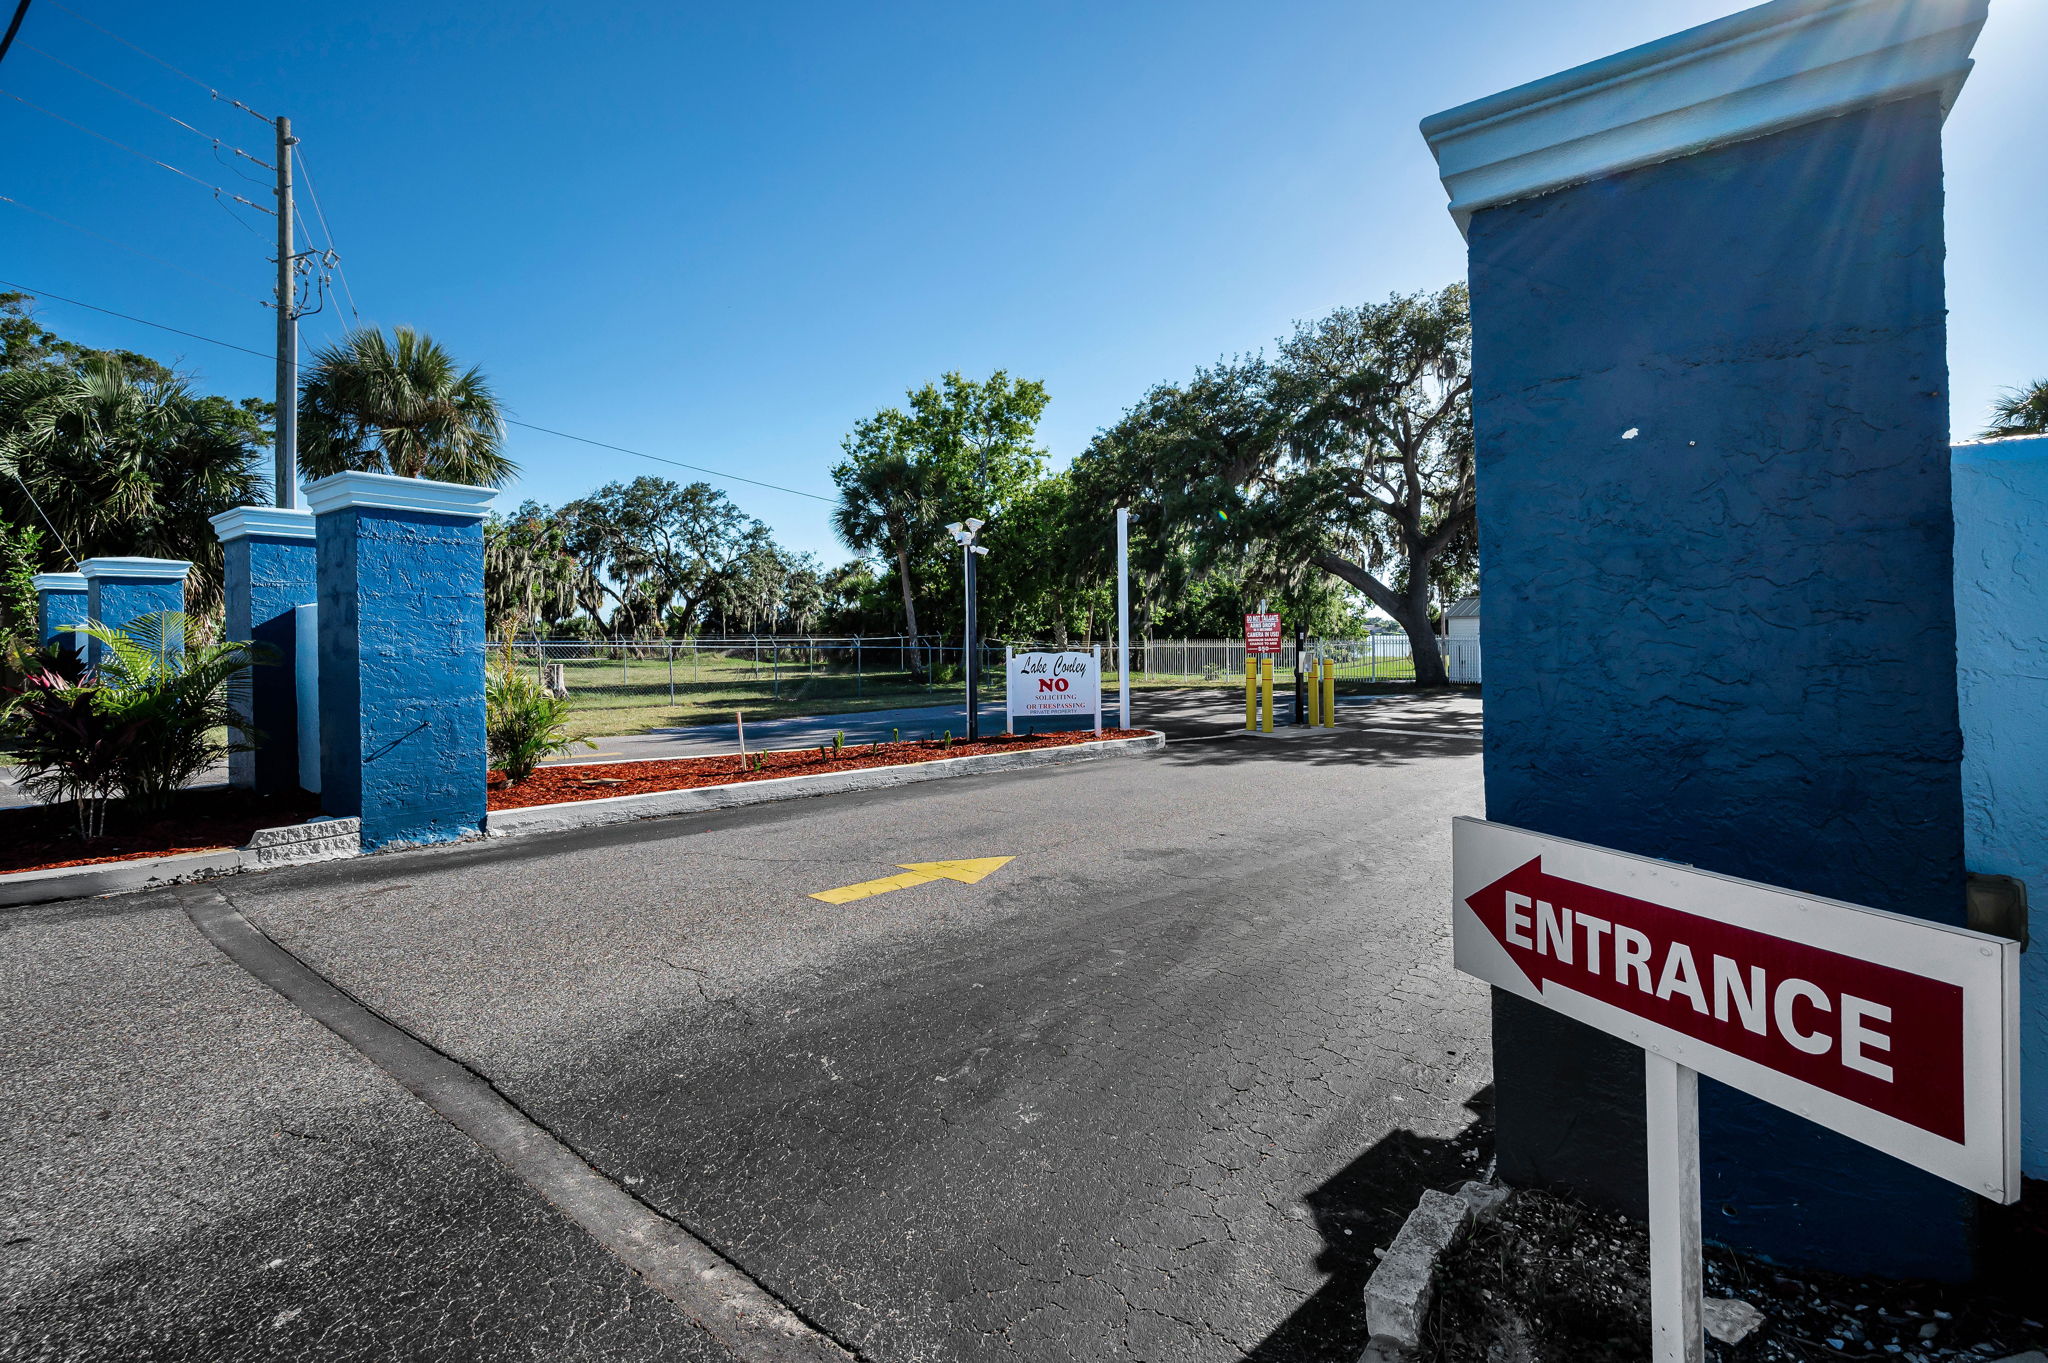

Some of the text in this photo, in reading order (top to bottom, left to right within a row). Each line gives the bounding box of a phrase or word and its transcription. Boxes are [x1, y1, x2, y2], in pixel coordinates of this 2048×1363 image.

[1020, 656, 1086, 678] Lake Conley
[1038, 678, 1068, 692] NO
[1505, 890, 1894, 1083] ENTRANCE
